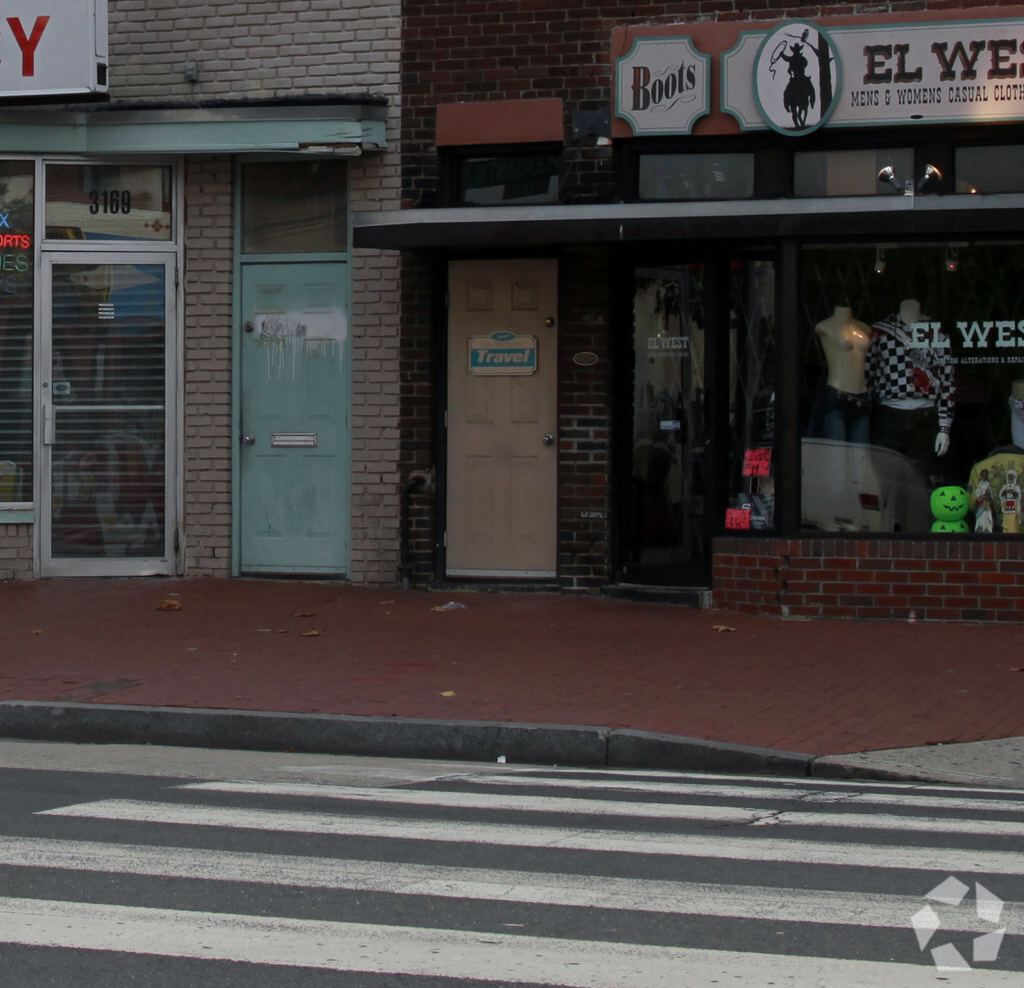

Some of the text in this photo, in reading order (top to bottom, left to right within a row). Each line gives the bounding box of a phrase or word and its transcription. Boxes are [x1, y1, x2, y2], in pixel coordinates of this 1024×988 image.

[863, 38, 1024, 85] EL WE
[631, 59, 696, 111] Boots
[851, 90, 879, 107] MENS
[884, 89, 891, 106] &
[896, 87, 942, 105] WOMENS
[948, 84, 988, 103] CASUAL
[89, 189, 132, 215] 3169
[648, 336, 689, 349] EL WEST
[908, 322, 950, 349] EL
[477, 348, 531, 363] Travel
